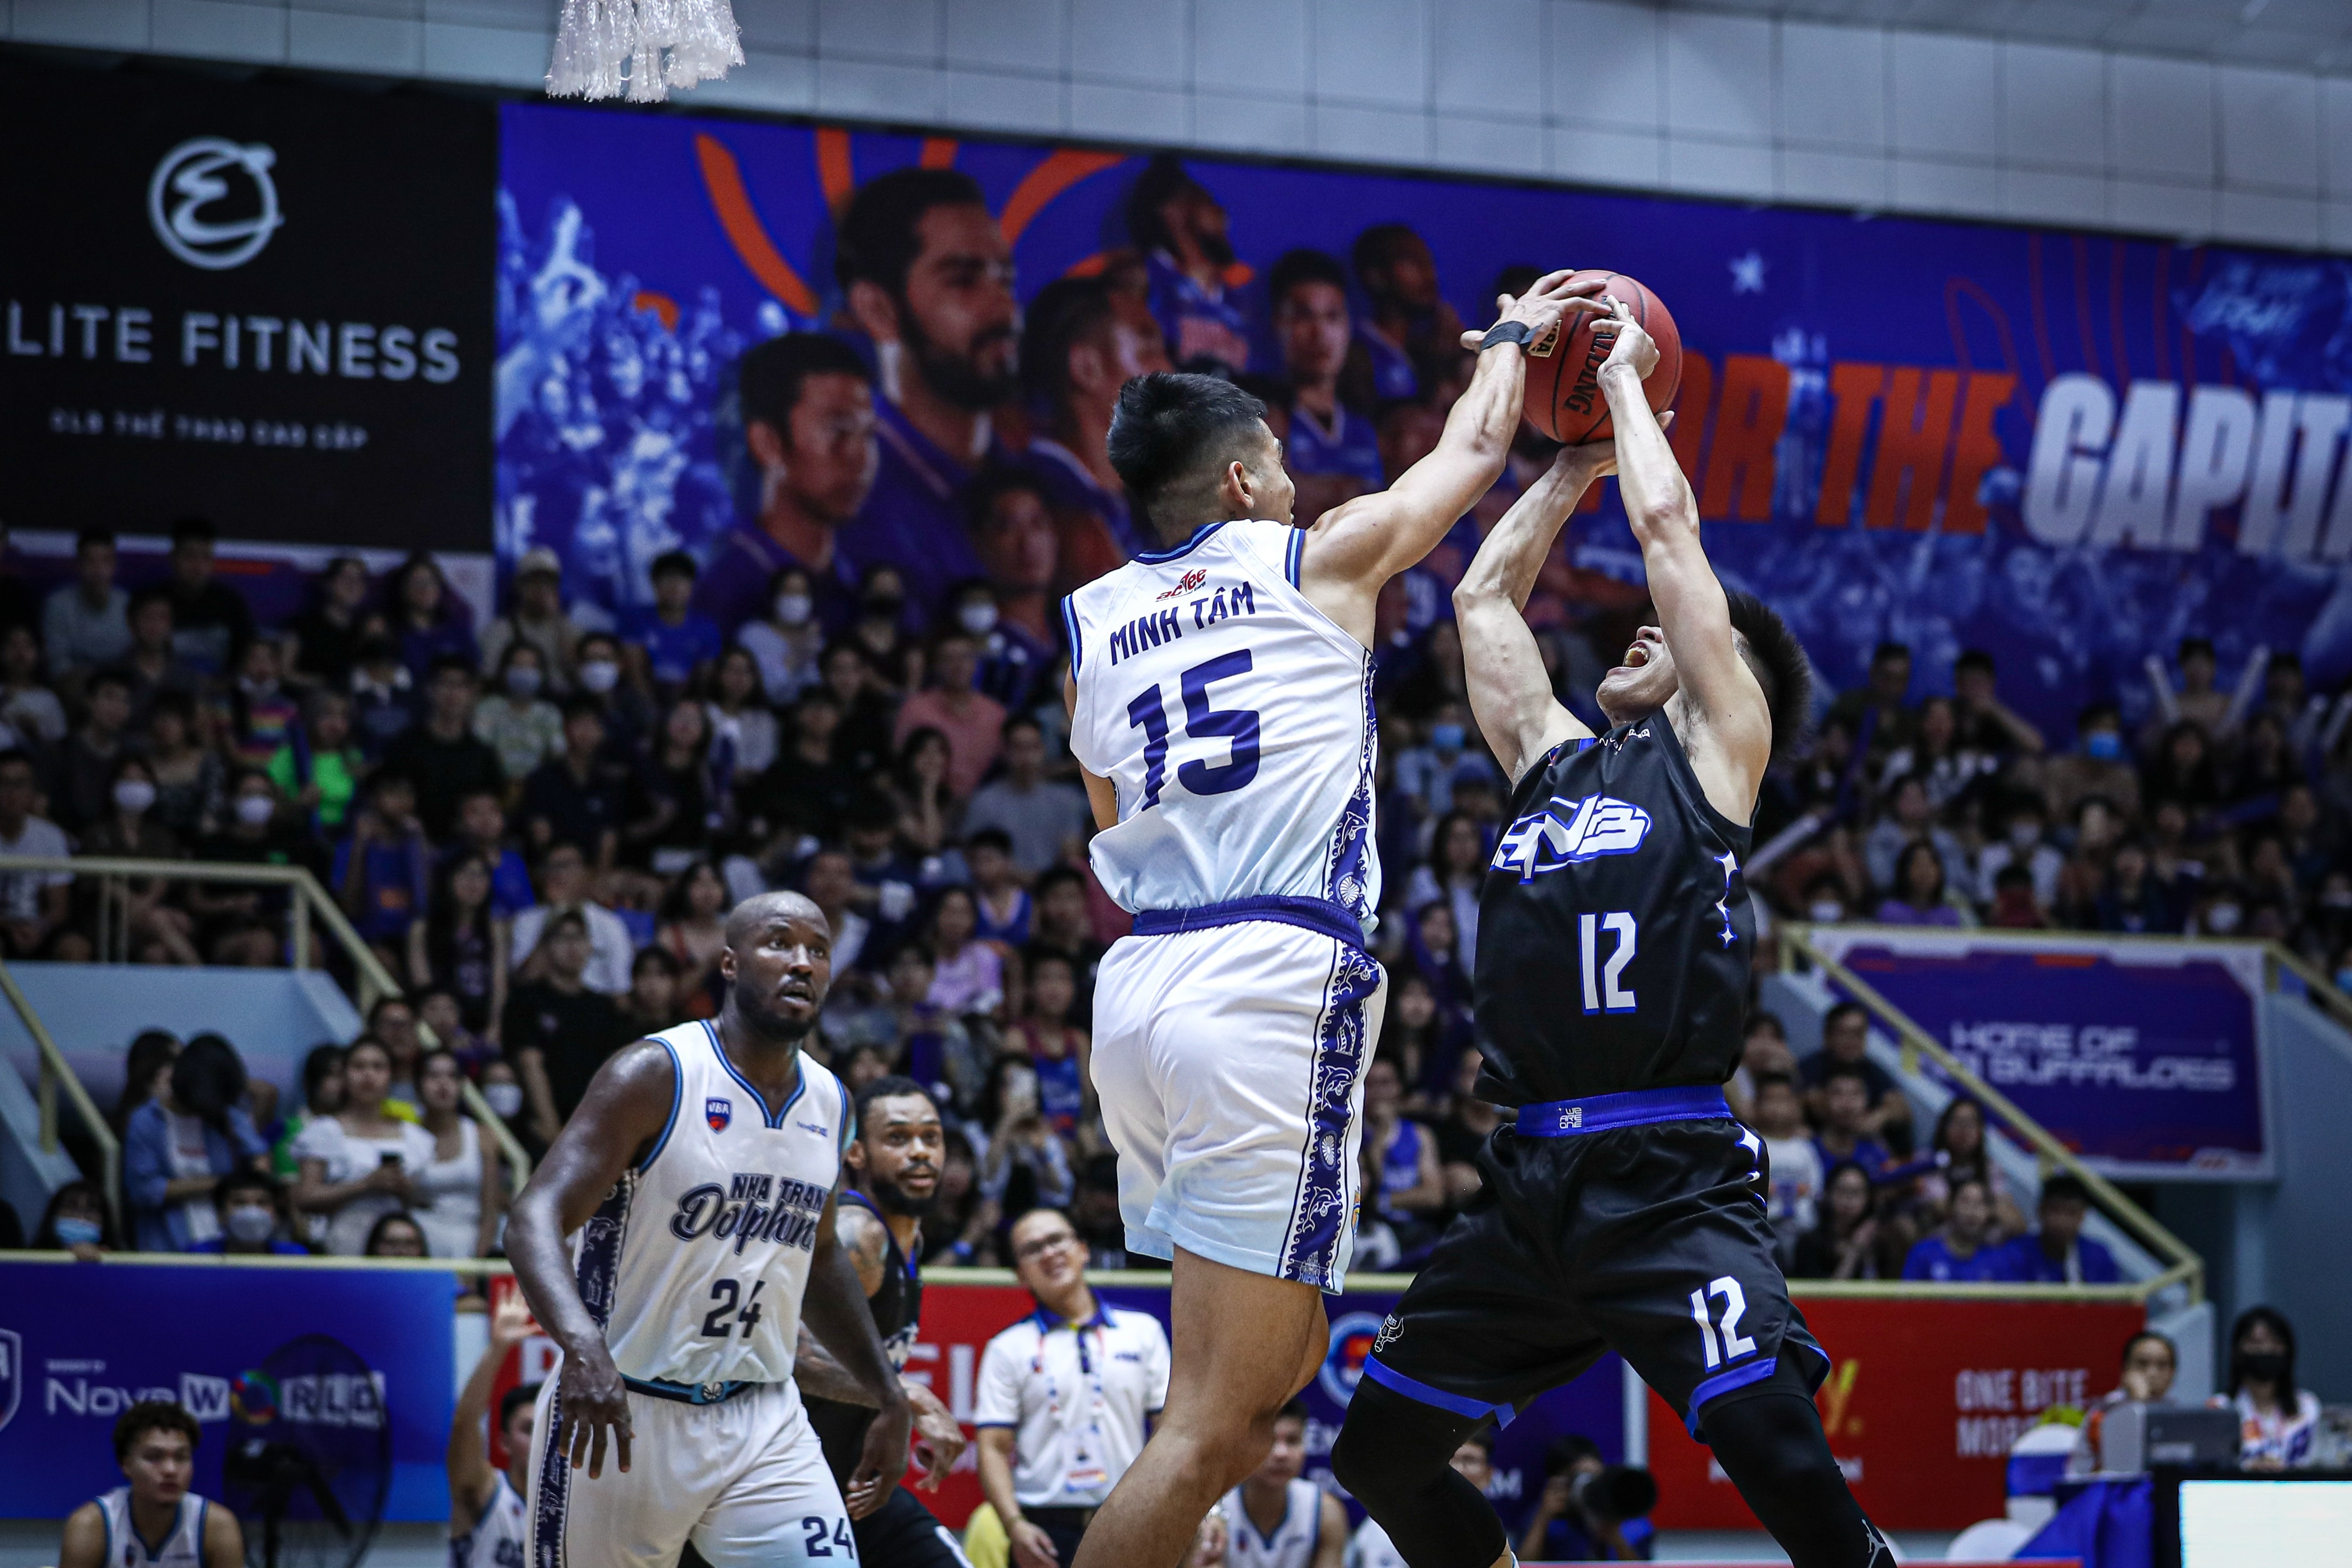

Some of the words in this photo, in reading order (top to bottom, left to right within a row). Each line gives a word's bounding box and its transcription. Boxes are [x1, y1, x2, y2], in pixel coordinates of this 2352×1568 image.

[8, 299, 152, 364] LITE
[183, 310, 461, 384] FITNESS
[1814, 359, 2018, 537] THE
[1110, 606, 1182, 666] MINH
[1190, 581, 1255, 630] TÂM
[1126, 648, 1261, 812] 15
[1577, 909, 1638, 1015] 12
[1559, 1114, 1582, 1122] ARE
[1559, 1120, 1582, 1129] ONE
[727, 1172, 774, 1202] NHA
[701, 1278, 766, 1338] 24
[1688, 1275, 1758, 1374] 12
[1955, 1368, 2014, 1412] ONE
[1956, 1414, 2041, 1458] MOR
[801, 1515, 855, 1560] 24
